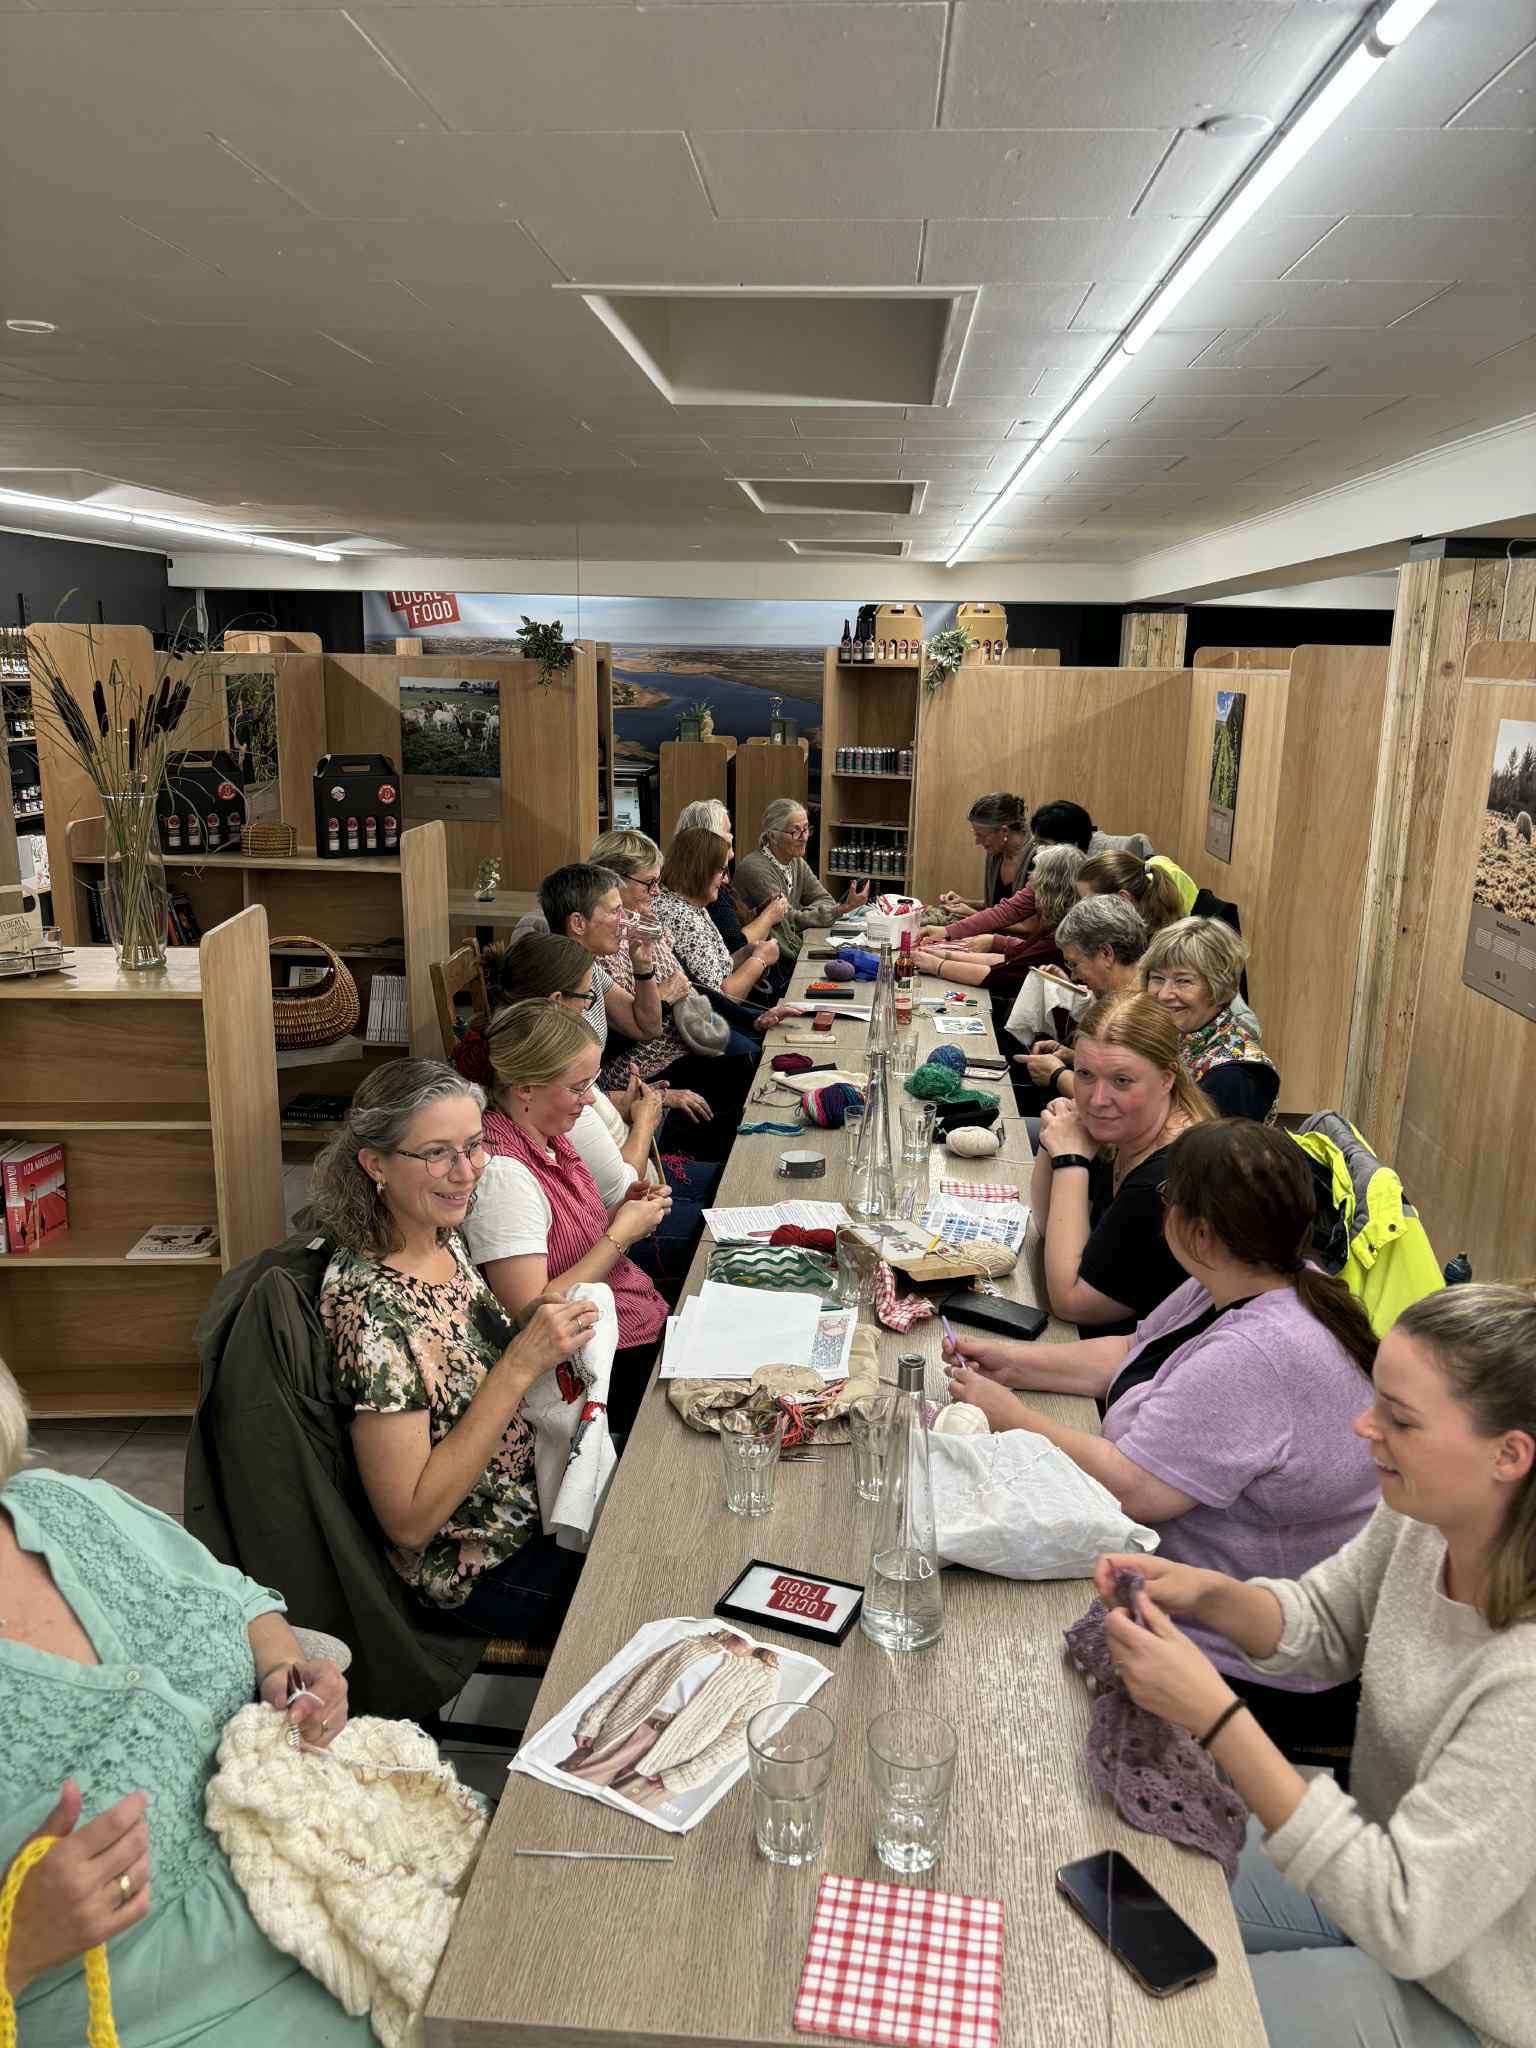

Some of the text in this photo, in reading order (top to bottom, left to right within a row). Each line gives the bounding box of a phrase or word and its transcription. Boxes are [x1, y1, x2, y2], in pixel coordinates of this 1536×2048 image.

[412, 600, 453, 624] FOOD
[778, 1580, 821, 1600] FOOD
[780, 1593, 829, 1617] LOCAL
